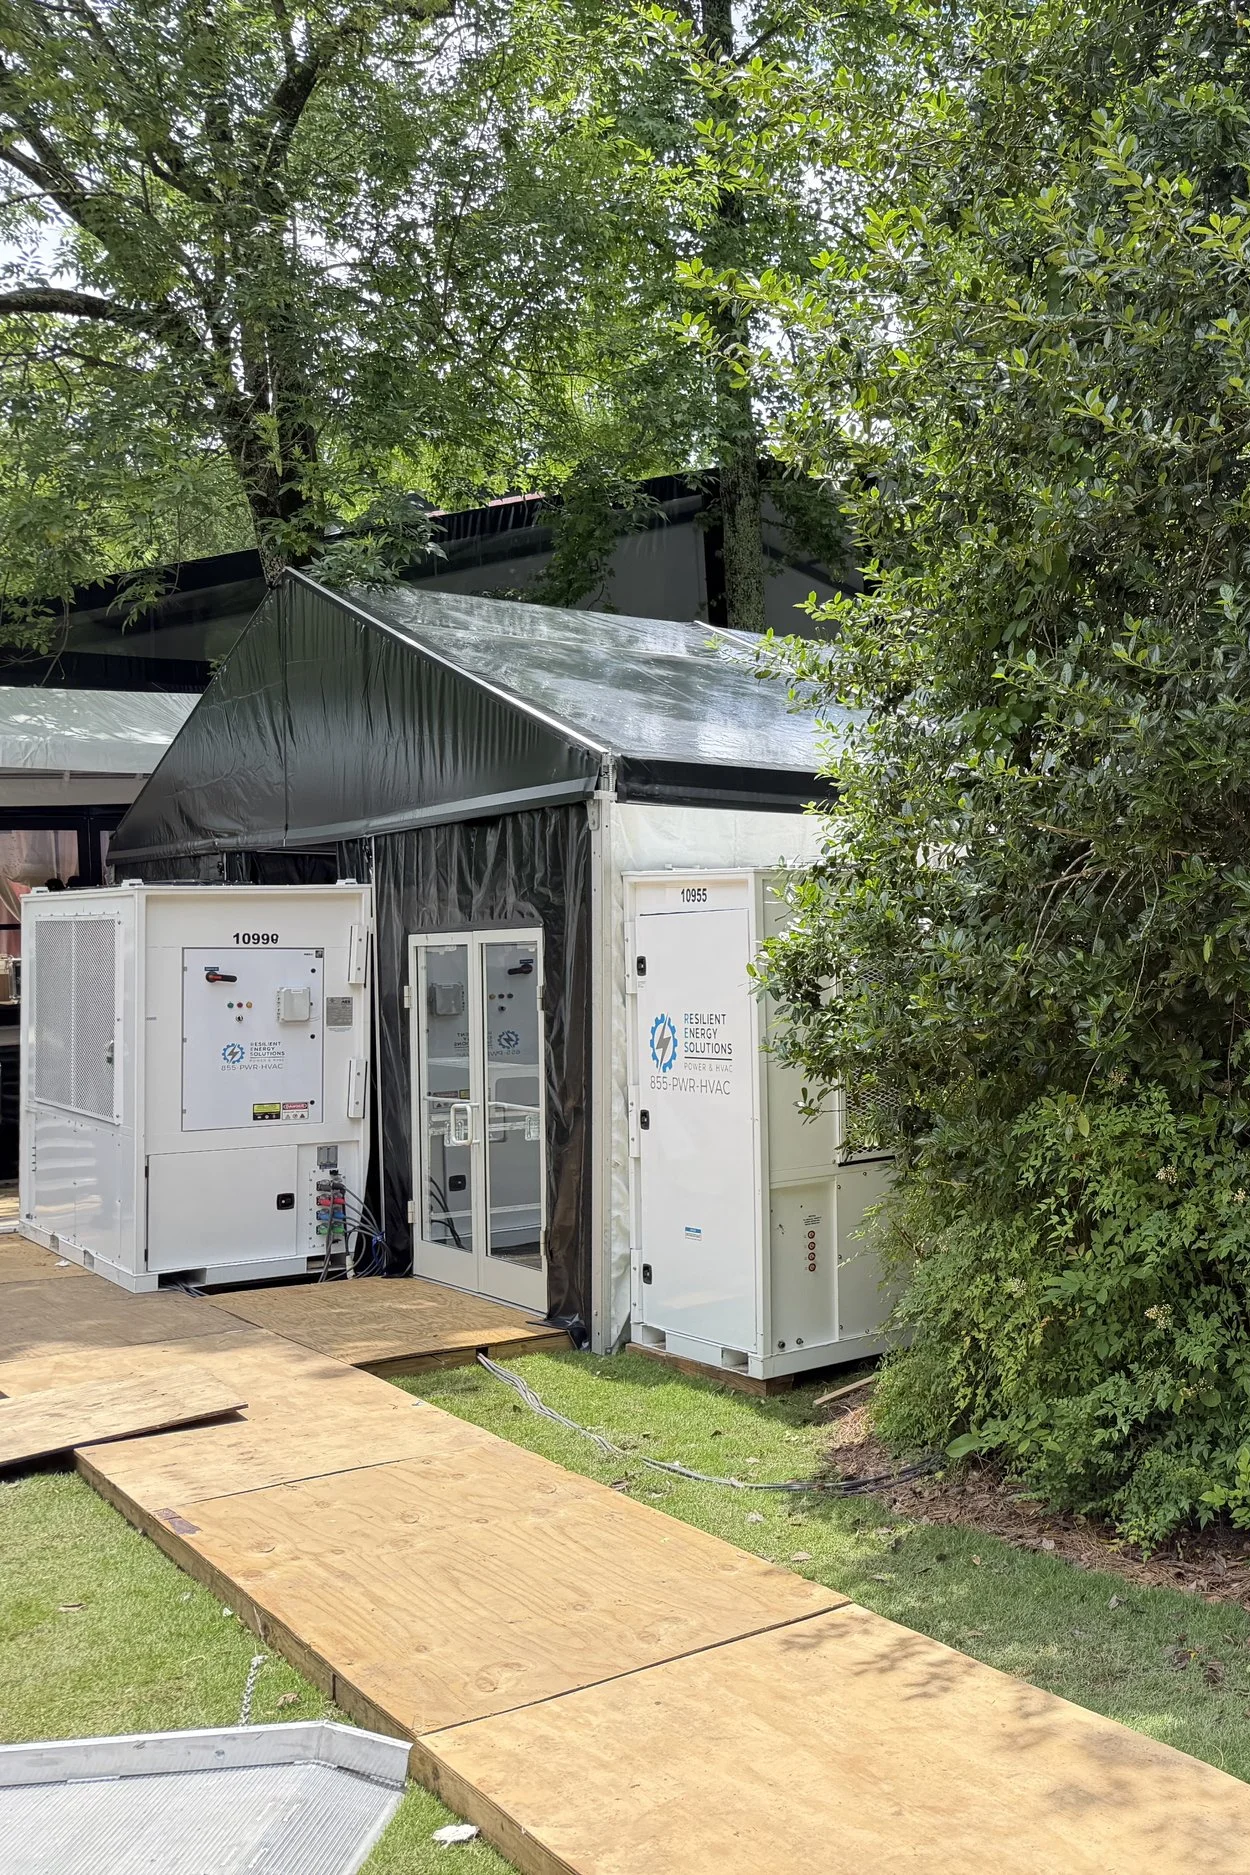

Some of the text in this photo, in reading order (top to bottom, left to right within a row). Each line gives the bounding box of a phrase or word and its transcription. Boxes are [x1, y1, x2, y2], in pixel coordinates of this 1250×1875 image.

[681, 888, 707, 902] 10955
[684, 1013, 726, 1025] RESILIENT
[684, 1028, 717, 1039] ENERGY
[684, 1041, 732, 1055] SOLUTIONS
[684, 1062, 732, 1072] POWER & HVAC
[650, 1075, 730, 1095] 855-PWR-HVAC
